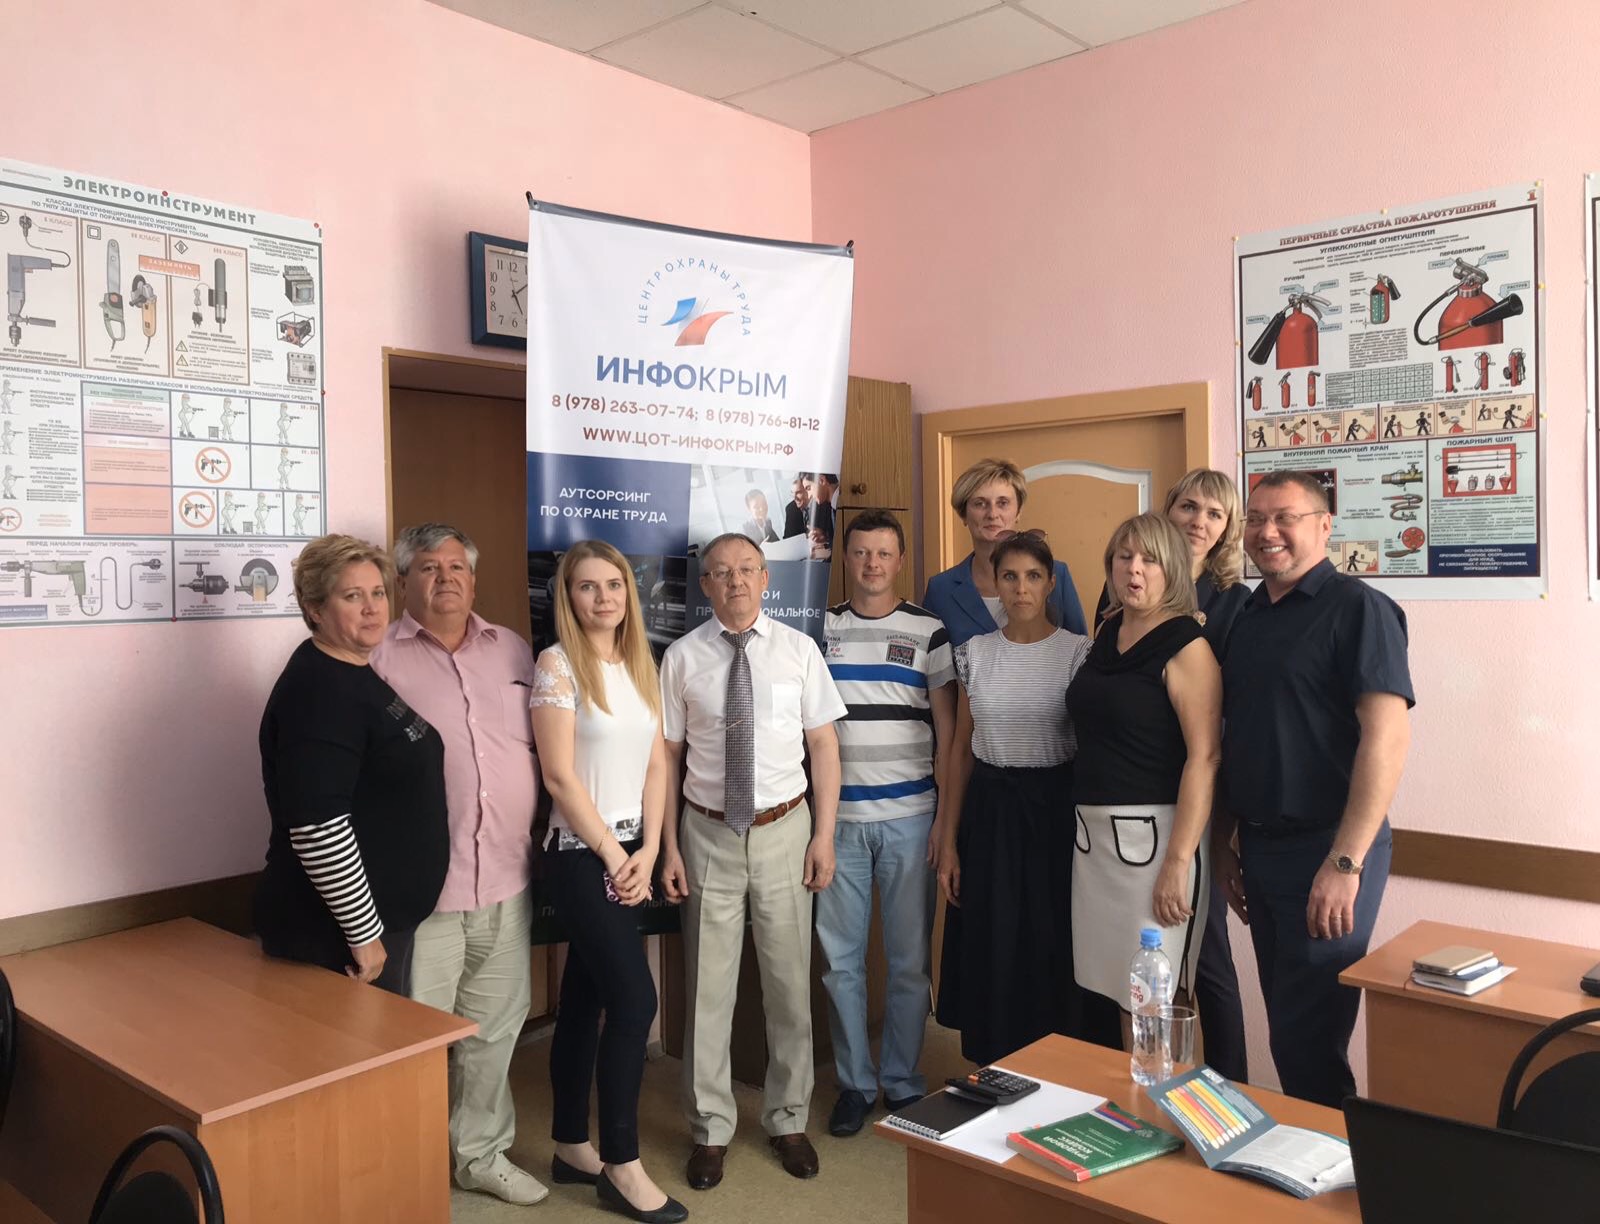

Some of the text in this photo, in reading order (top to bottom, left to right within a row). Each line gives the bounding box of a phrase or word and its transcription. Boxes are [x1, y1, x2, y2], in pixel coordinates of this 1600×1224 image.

[63, 175, 257, 226] ЭЛЕКТРОИНСТРУМЕНТ
[1279, 200, 1497, 246] ПЕРВИЧНЫЕ СРЕДСТВА ПОЖАРОТУШЕНИЯ
[1320, 229, 1436, 255] УГЛЕКИСЛОТНЫЕ ОГНЕТУШИТЕЛИ
[509, 262, 518, 273] 12
[490, 271, 498, 283] 10
[490, 286, 496, 297] 9
[637, 257, 753, 337] ЦЕНТР ОХРАНЫ ТРУДА
[490, 301, 497, 312] 8
[498, 315, 505, 325] 7
[511, 318, 518, 328] 6
[596, 354, 788, 400] ИНФОКРЫМ
[551, 394, 821, 432] 8 (978) 263-07-74; 8 (978) 766-81-12
[582, 426, 794, 457] WWW.ЦОТ-ИНФОКРЫМ.РФ
[1446, 438, 1493, 447] ПОЖАРНЫЙ
[1327, 446, 1368, 455] ПОЖАРНЫЙ
[559, 487, 652, 504] АУТСОРСИНГ
[540, 505, 668, 524] ПО ОХРАНЕ ТРУДА
